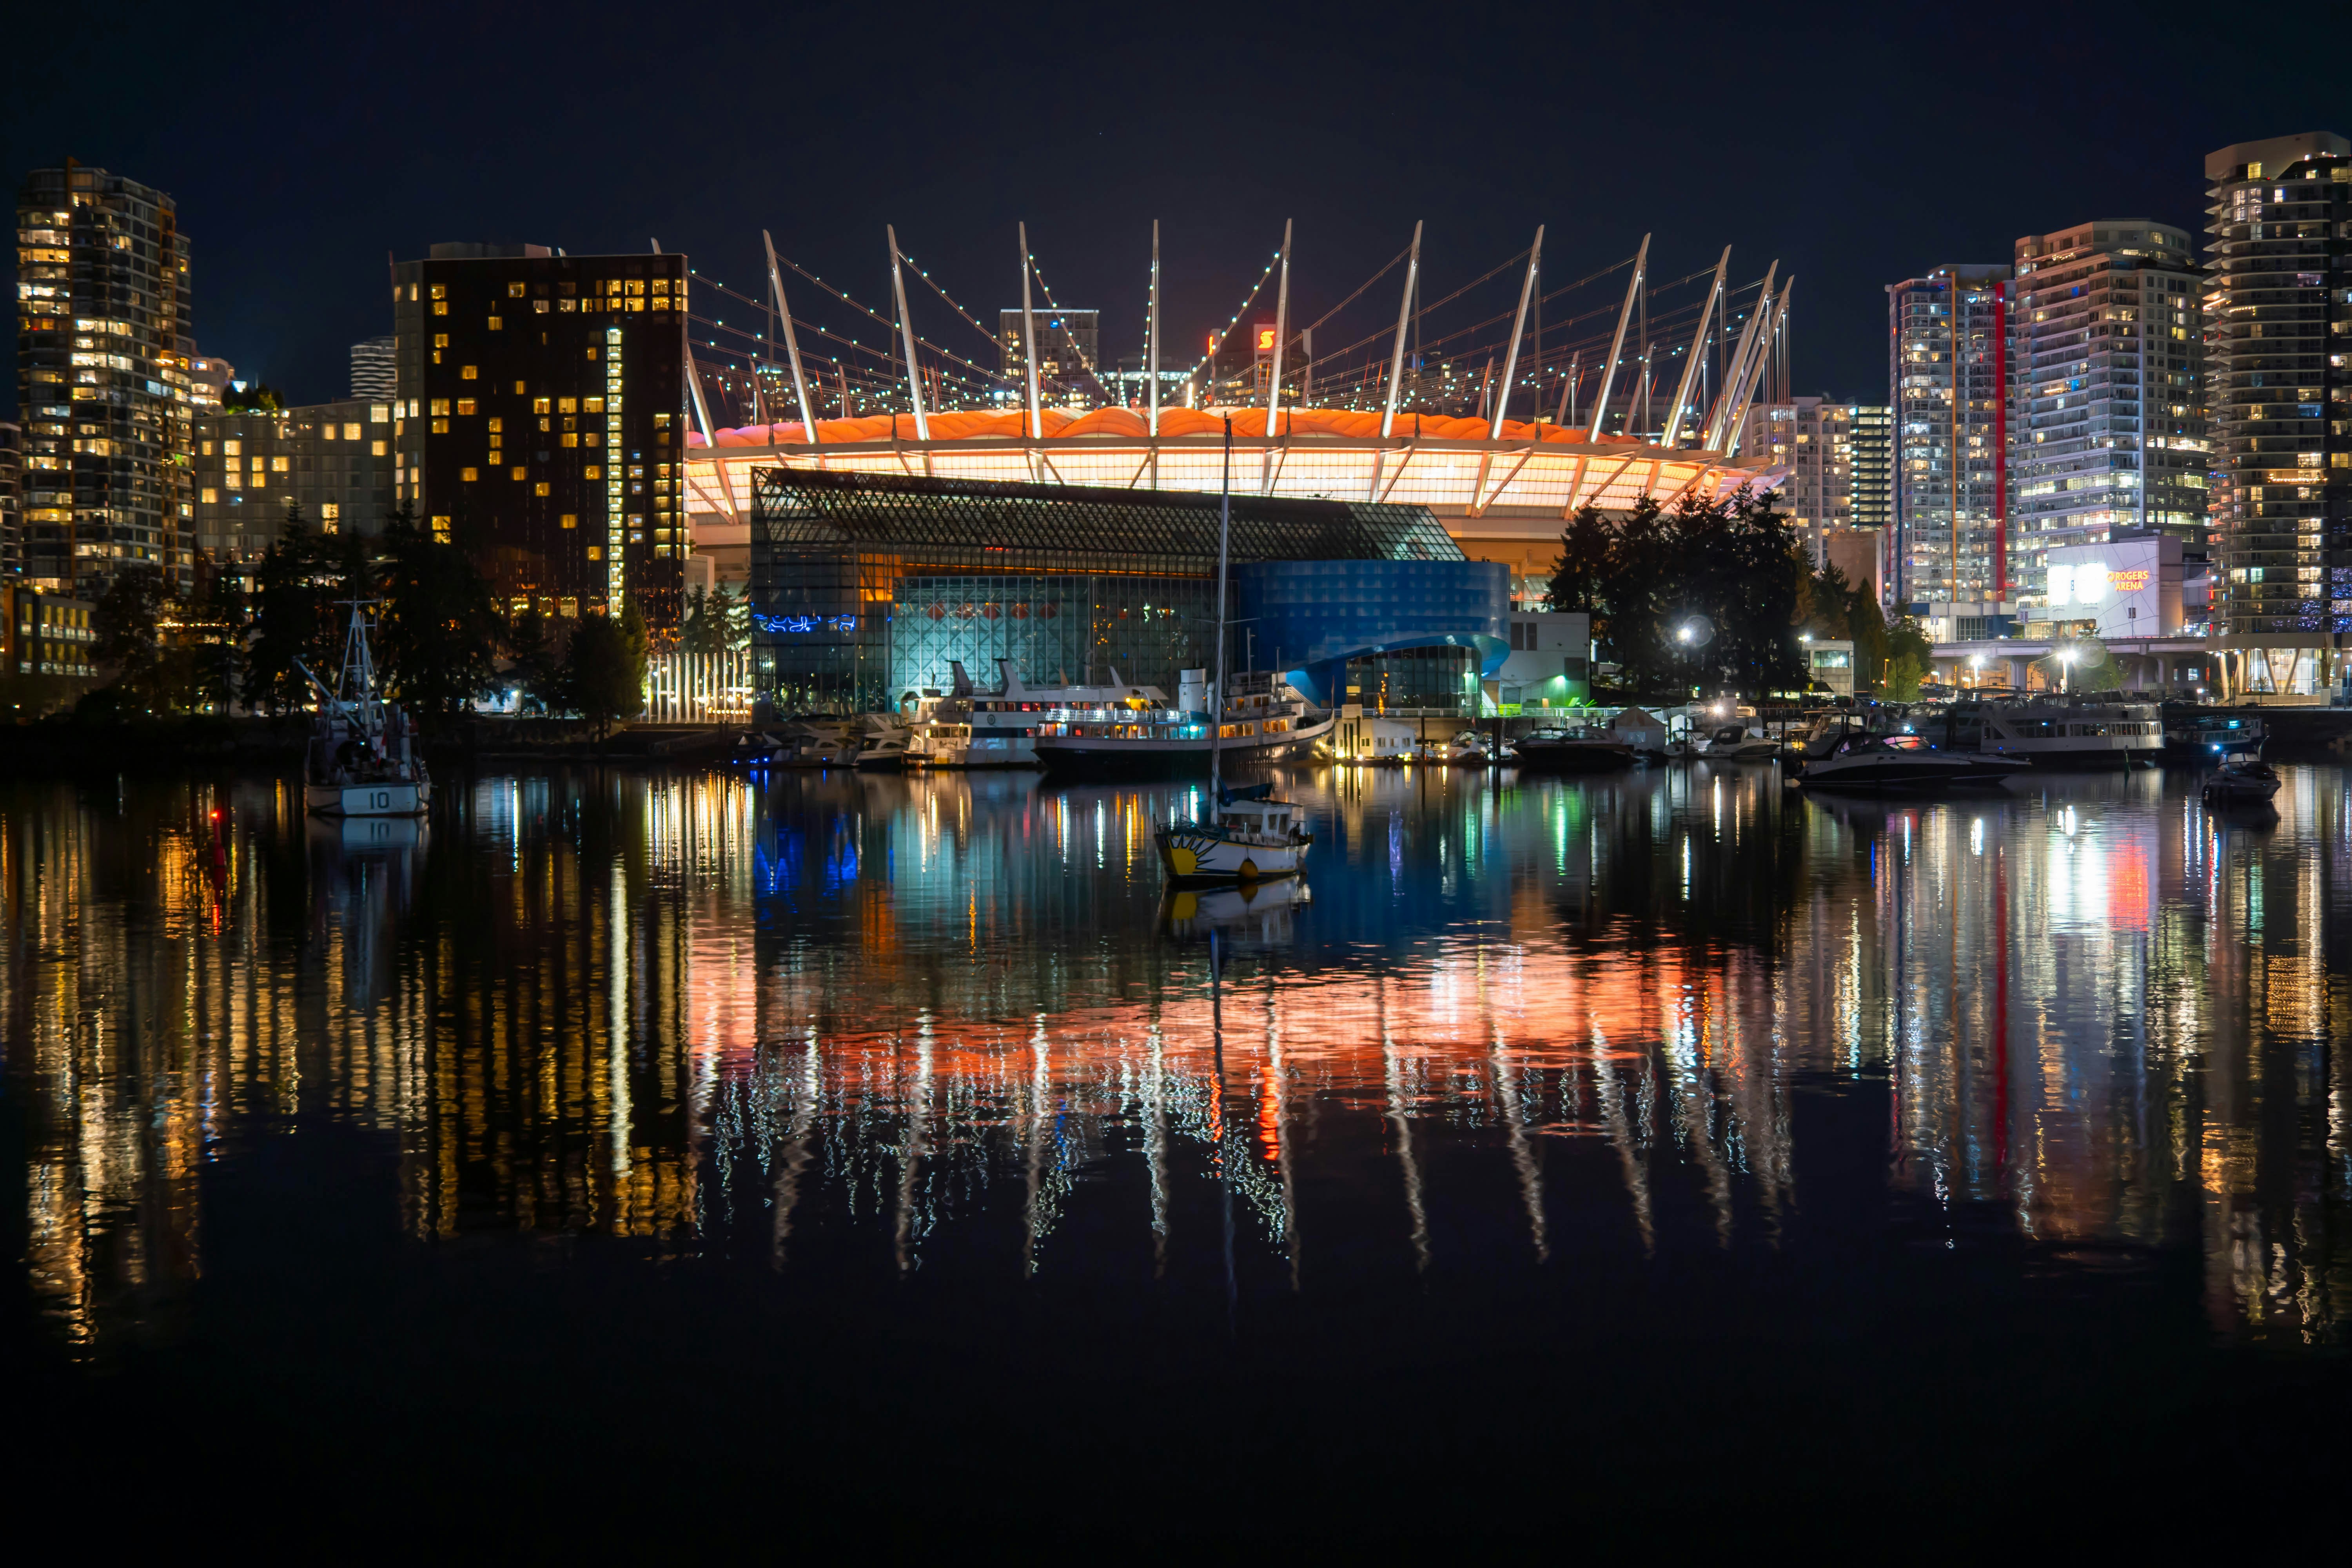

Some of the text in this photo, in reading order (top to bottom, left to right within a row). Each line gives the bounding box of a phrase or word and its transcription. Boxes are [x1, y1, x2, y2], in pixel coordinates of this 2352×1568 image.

[2115, 571, 2149, 581] ROGERS
[2115, 581, 2143, 590] ARENA
[370, 792, 389, 809] 10
